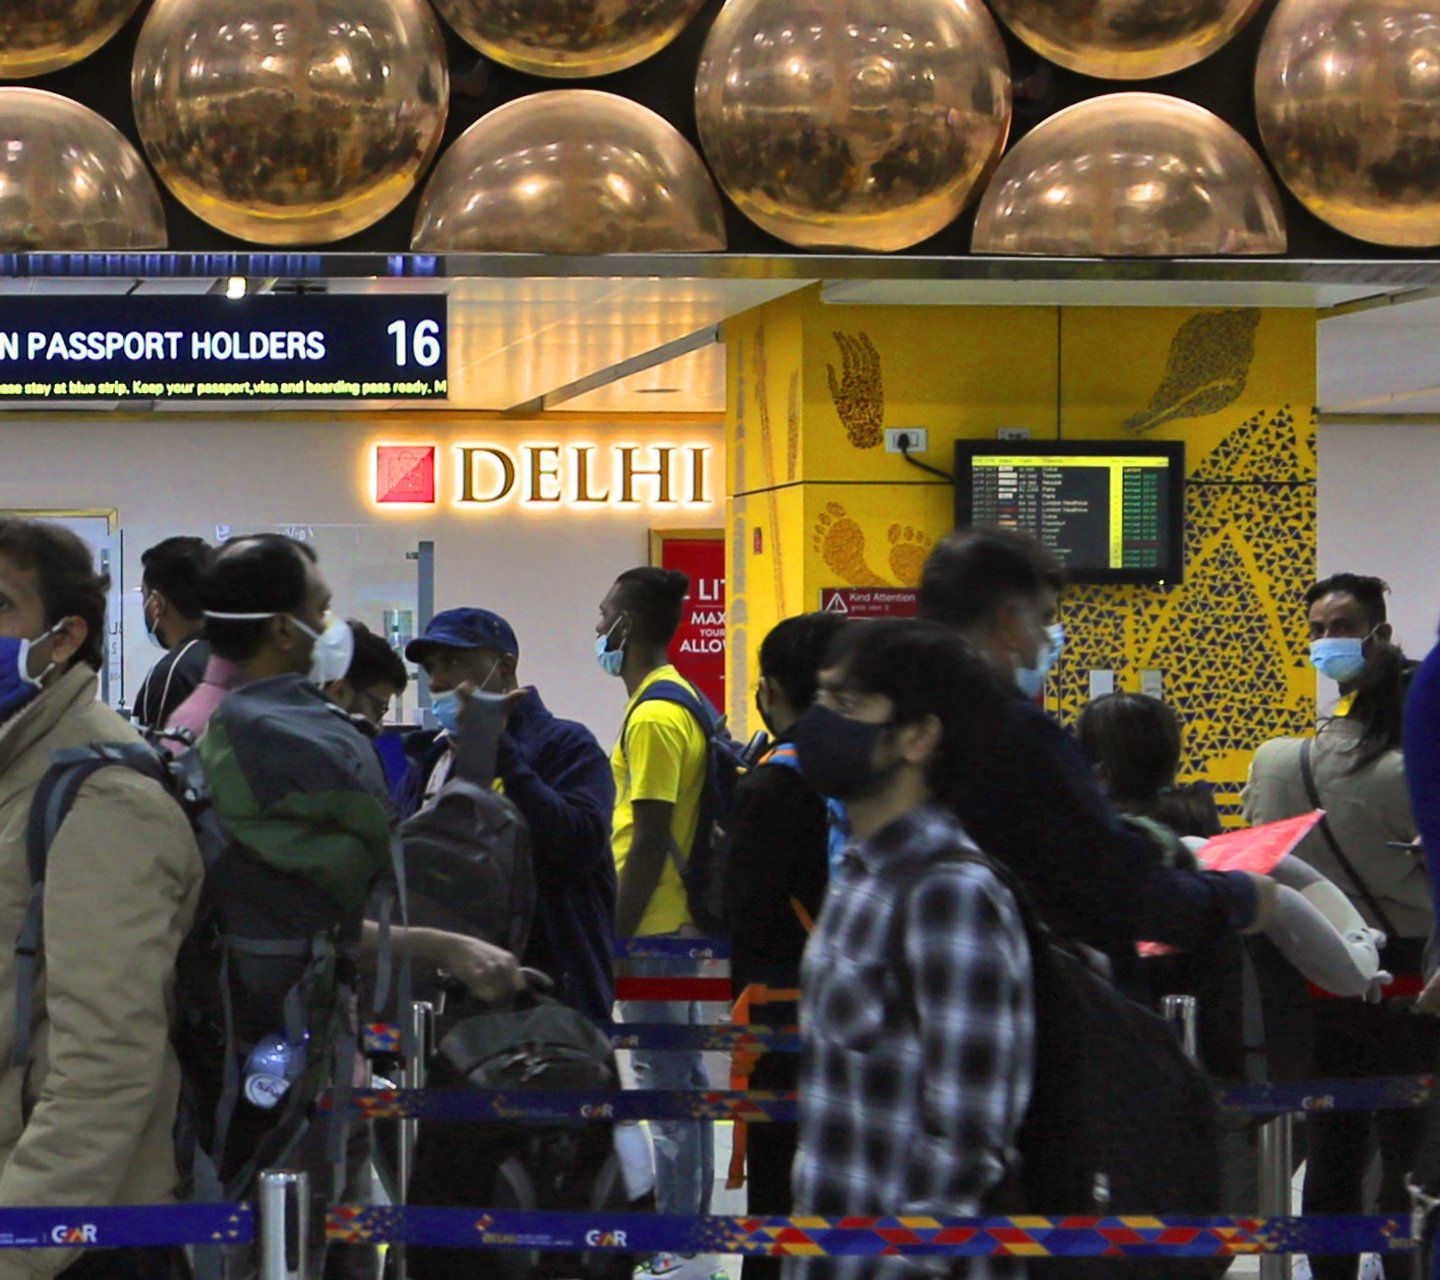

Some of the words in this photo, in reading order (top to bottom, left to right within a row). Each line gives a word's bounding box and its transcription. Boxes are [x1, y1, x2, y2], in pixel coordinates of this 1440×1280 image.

[28, 332, 183, 360] PASSPORT
[191, 331, 326, 360] HOLDERS
[387, 319, 441, 367] 16
[24, 382, 51, 397] stay
[54, 382, 67, 395] at
[69, 381, 96, 395] blue
[132, 381, 164, 396] Keep
[166, 384, 195, 396] your
[281, 381, 304, 394] and
[305, 380, 360, 396] boarding
[362, 384, 391, 396] pass
[456, 446, 712, 503] DELHI
[849, 592, 870, 602] Kind
[873, 592, 915, 602] Attention
